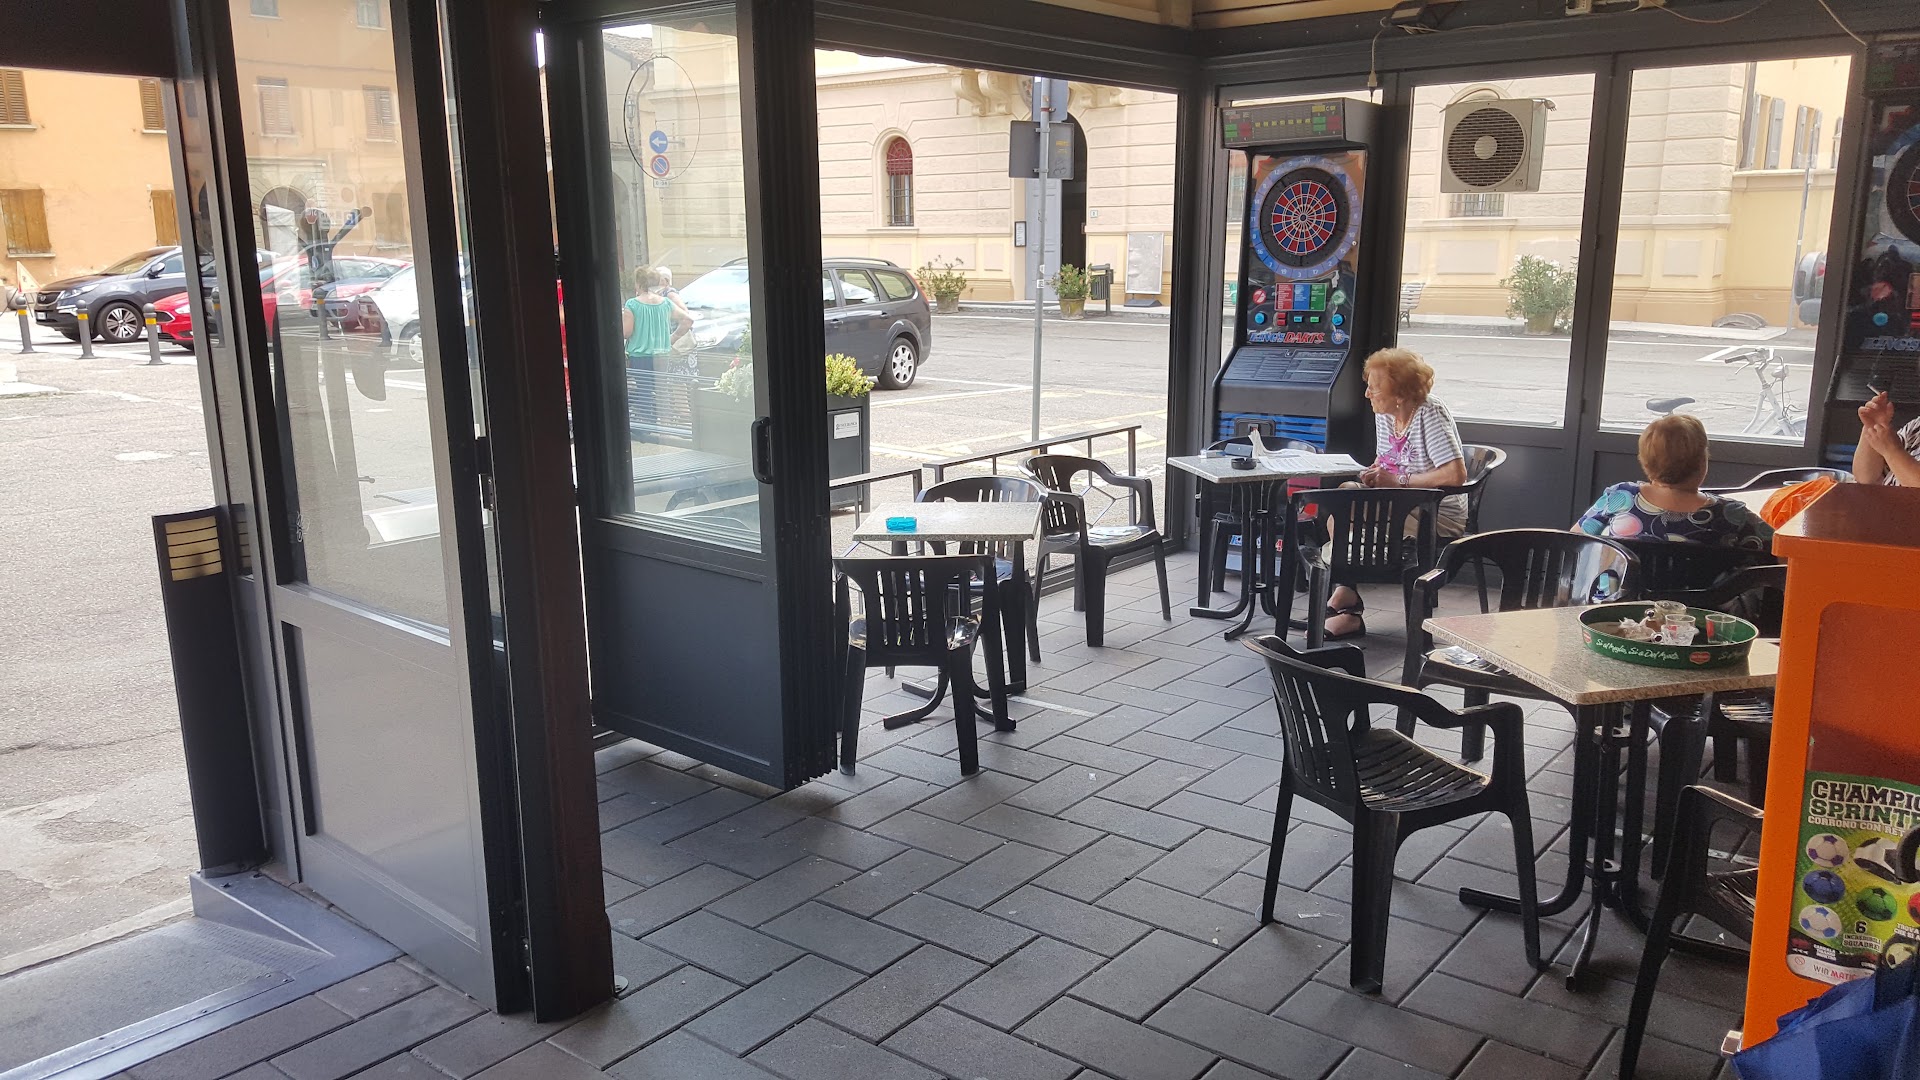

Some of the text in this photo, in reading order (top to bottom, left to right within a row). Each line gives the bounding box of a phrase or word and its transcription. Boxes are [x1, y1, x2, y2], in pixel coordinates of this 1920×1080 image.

[1284, 331, 1325, 344] DARTS
[1808, 815, 1857, 829] CORRONO
[1859, 822, 1883, 832] CON
[1855, 920, 1868, 933] 6
